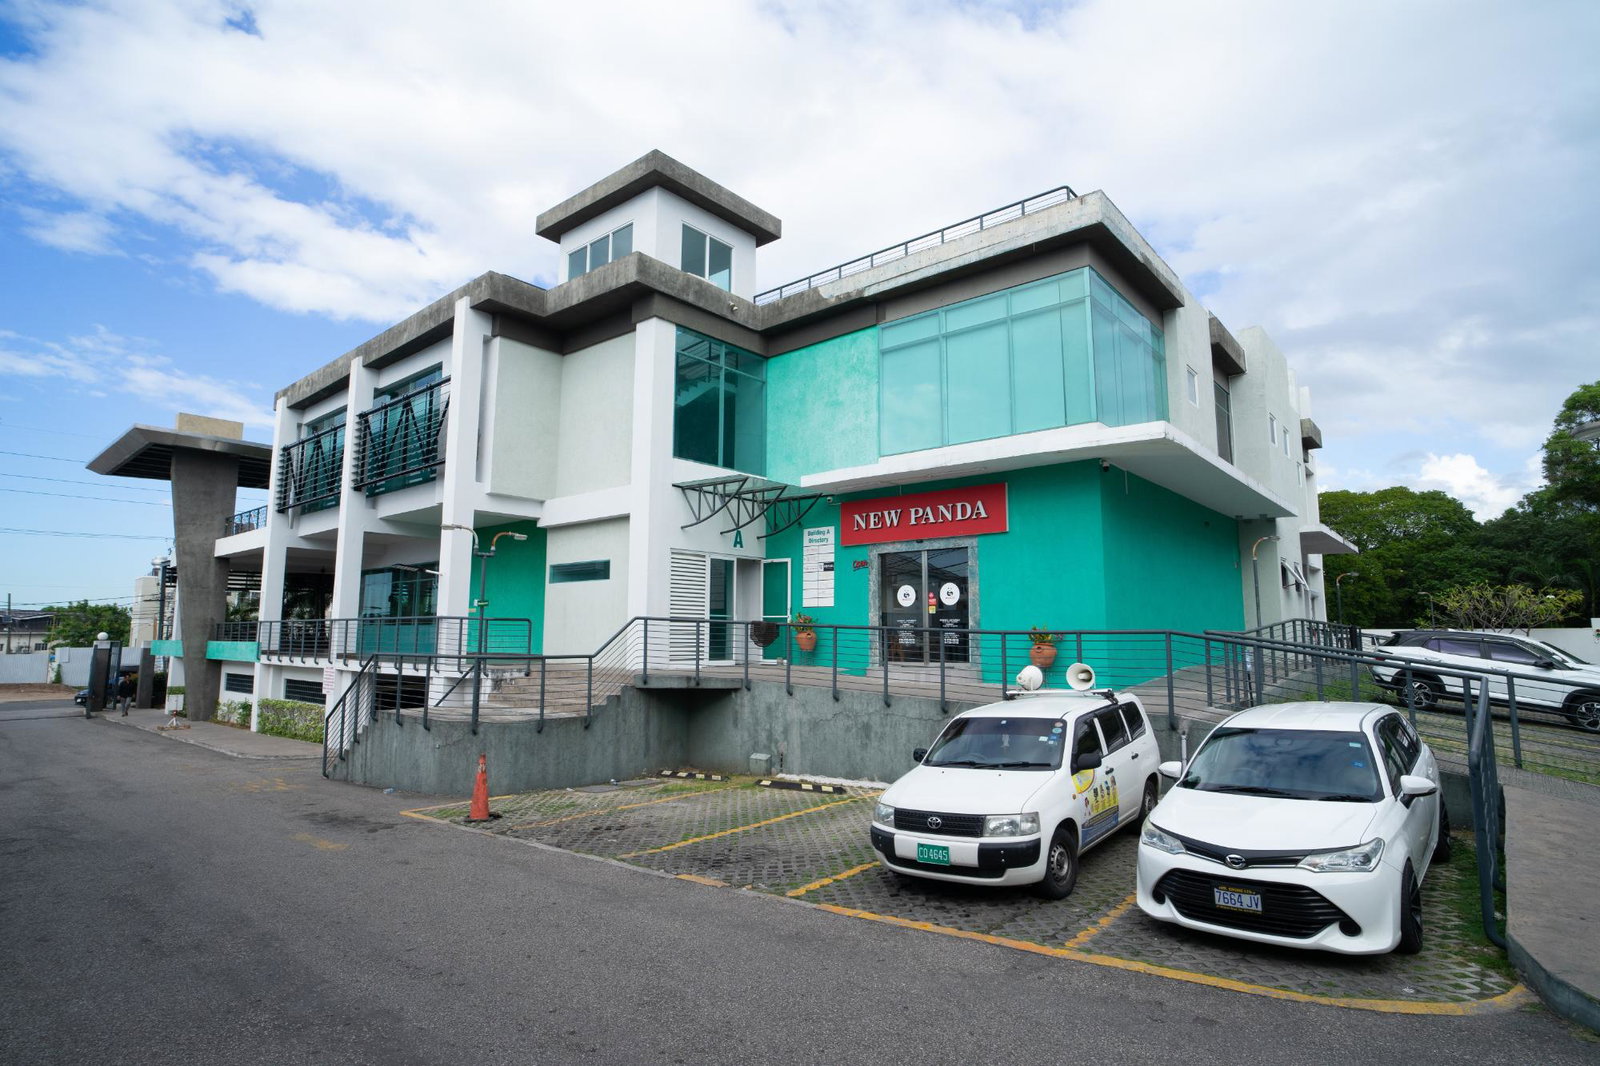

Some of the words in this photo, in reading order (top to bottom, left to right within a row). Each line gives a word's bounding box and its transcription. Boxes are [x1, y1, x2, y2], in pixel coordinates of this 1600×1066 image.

[853, 508, 902, 530] NEW
[909, 499, 989, 525] PANDA
[733, 529, 744, 549] A
[807, 529, 826, 537] Building
[928, 849, 948, 861] 4645
[1215, 890, 1244, 907] 7664
[1246, 895, 1260, 909] JV
